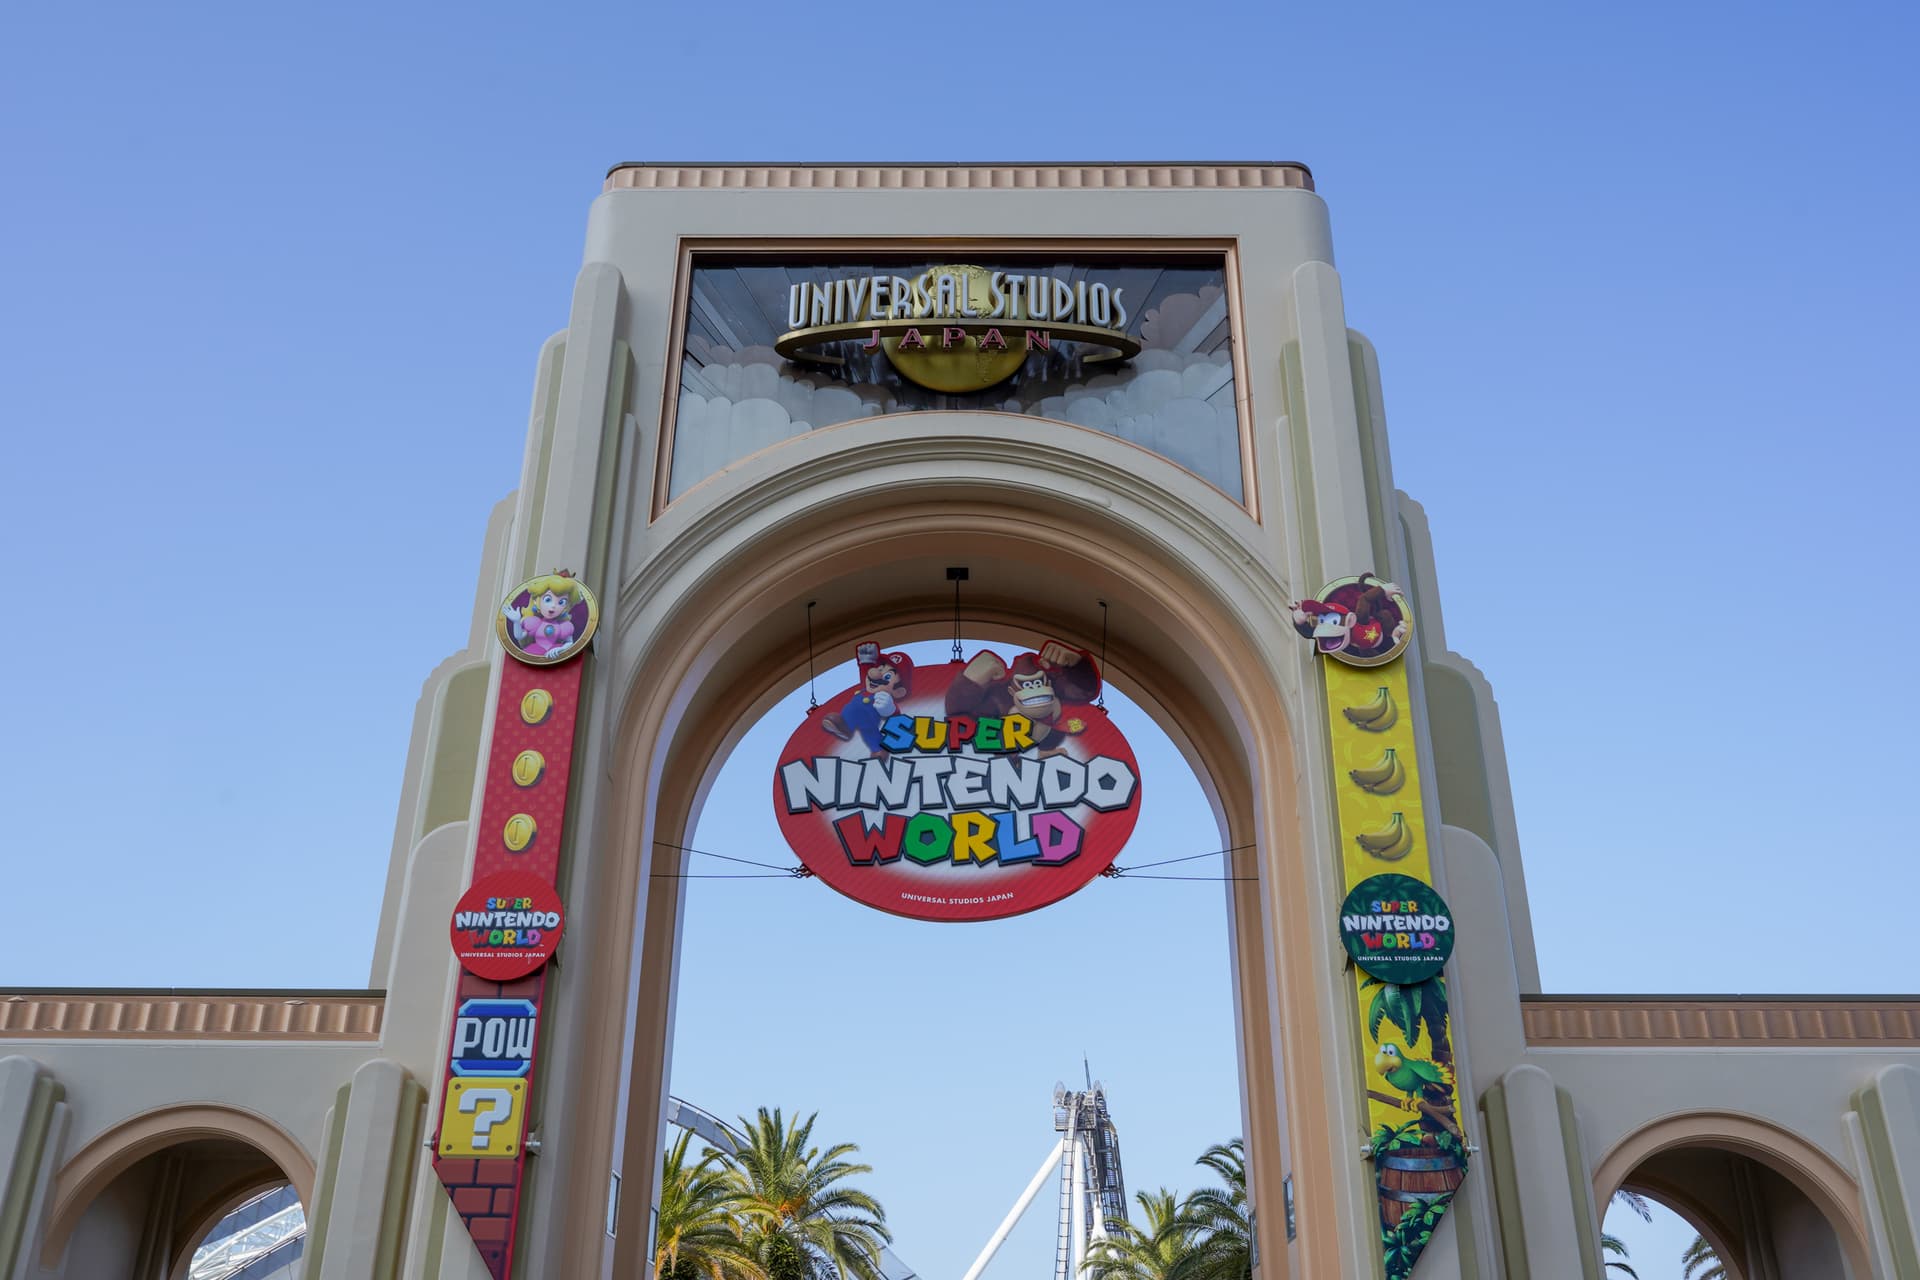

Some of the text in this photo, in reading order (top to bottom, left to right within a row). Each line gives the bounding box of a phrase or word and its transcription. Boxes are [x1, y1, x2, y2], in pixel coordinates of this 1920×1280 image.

[789, 271, 1128, 329] UNIVERSAL STUDIOS
[862, 327, 1050, 351] JAPAN
[880, 713, 1036, 753] SUPER
[780, 755, 1138, 814] NINTENDO
[833, 810, 1085, 867] WORLD
[486, 897, 533, 911] SUPER
[901, 892, 947, 904] UNIVERSAL
[987, 892, 1014, 903] JAPAN
[1371, 900, 1418, 913] SUPER
[455, 910, 561, 930] NINTENDO
[1342, 914, 1450, 932] NINTENDO
[470, 929, 542, 948] WORLD
[1361, 932, 1436, 950] WORLD
[452, 1017, 535, 1059] POW
